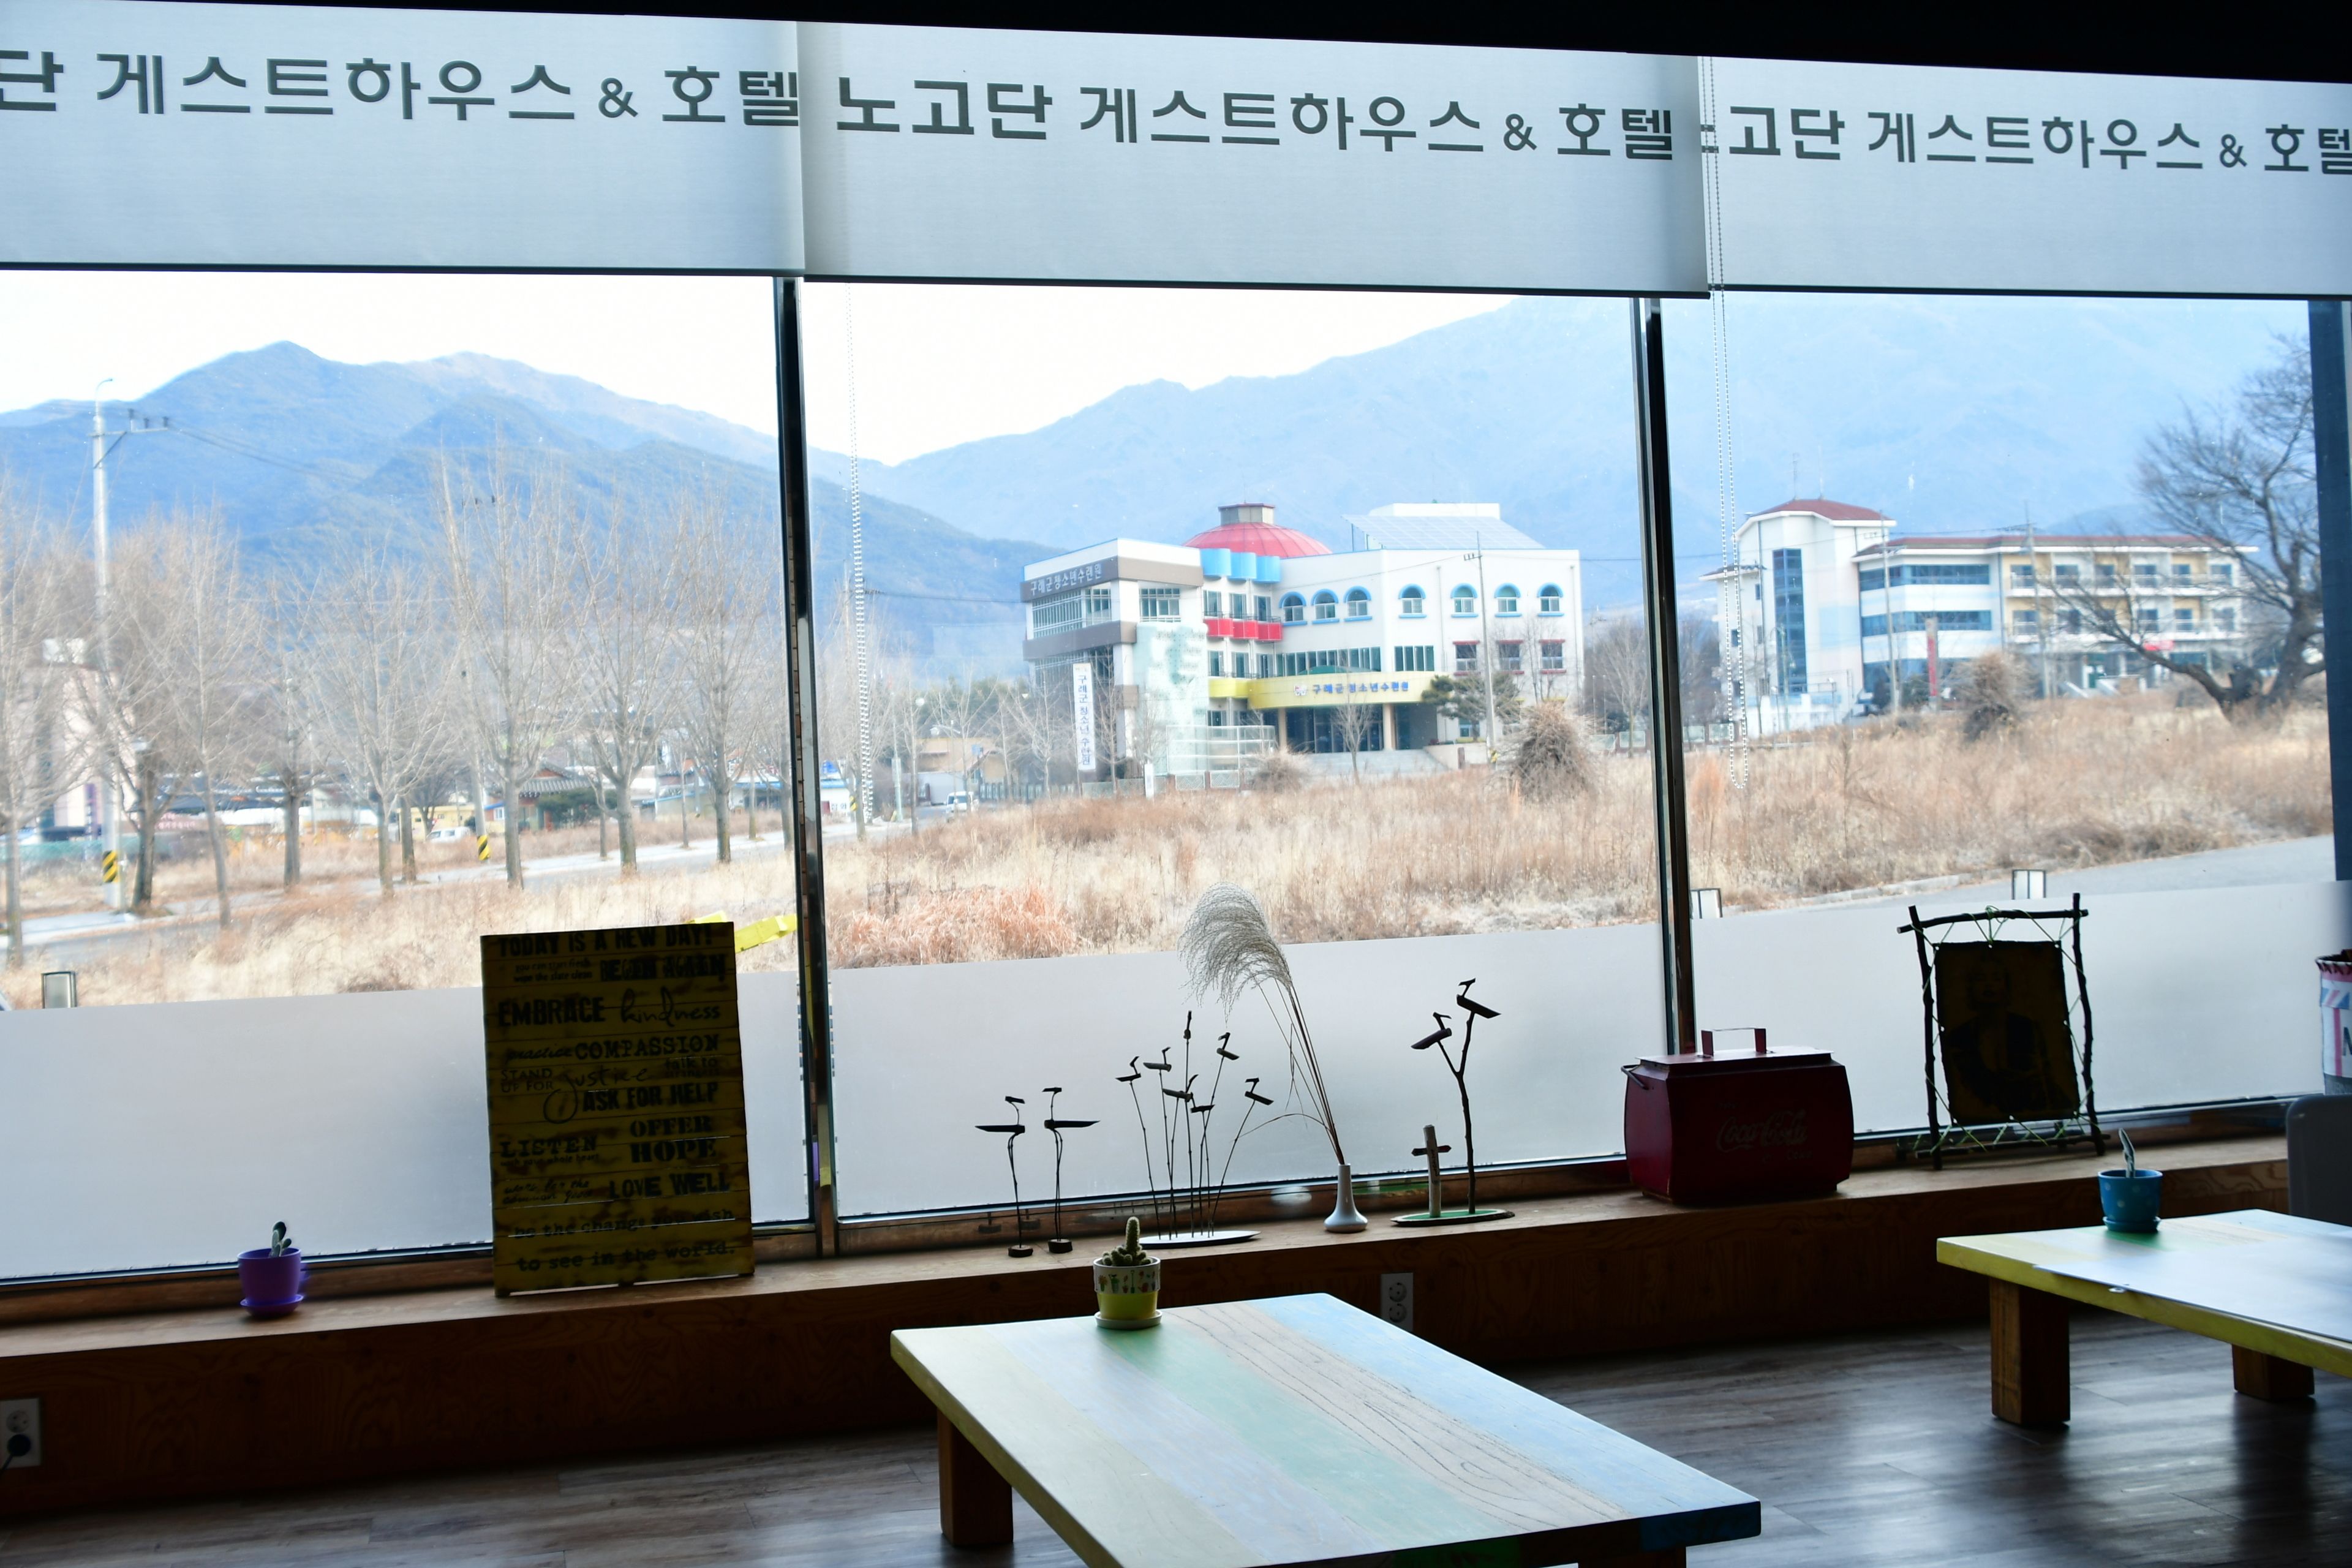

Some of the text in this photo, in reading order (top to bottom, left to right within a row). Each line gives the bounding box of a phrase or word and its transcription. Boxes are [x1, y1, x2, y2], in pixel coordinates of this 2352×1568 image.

[97, 53, 575, 121] 게스트하우스
[598, 78, 638, 118] &
[662, 66, 799, 127] 호텔
[837, 77, 1673, 161] 노고단 게스트하우스 & 호텔
[1868, 111, 2203, 170] 게스트하우스
[2219, 134, 2247, 168] &
[2264, 124, 2352, 176] 호텔
[498, 923, 712, 957] TODAY IS A NEW DAY!
[516, 963, 530, 973] you
[568, 957, 590, 968] fresh
[535, 971, 549, 981] the
[550, 971, 569, 981] slate
[601, 957, 657, 982] BEGIN
[498, 987, 721, 1027] EMBRACE kindness
[505, 1034, 720, 1065] practice COMPASSION
[701, 1056, 718, 1068] to
[500, 1067, 552, 1080] STAND
[500, 1080, 554, 1093] UP FOR
[582, 1082, 718, 1112] ASK FOR HELP
[630, 1115, 712, 1137] OFFER
[1716, 1109, 1809, 1153] Coca-Cola
[499, 1135, 598, 1158] LISTEN
[630, 1139, 718, 1163] HOPE
[609, 1172, 731, 1199] LOVE WELL
[514, 1208, 733, 1239] be the change you wish
[517, 1242, 736, 1272] to see in the world.
